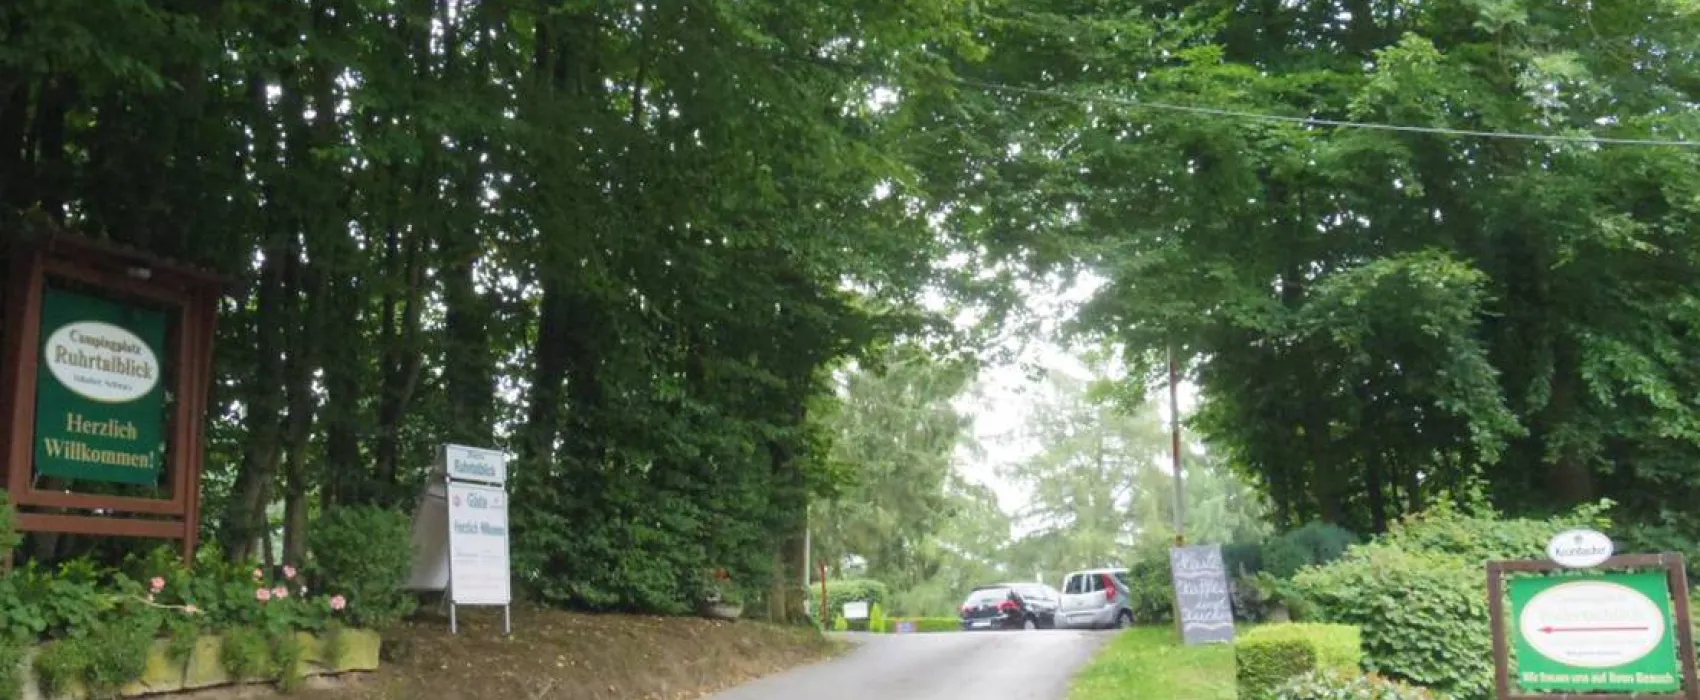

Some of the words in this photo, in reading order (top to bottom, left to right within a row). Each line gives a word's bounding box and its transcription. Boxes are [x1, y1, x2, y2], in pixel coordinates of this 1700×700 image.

[69, 328, 142, 355] Campingplatz
[54, 345, 153, 379] Ruhrtalblick
[66, 411, 138, 440] Herzlich
[44, 436, 154, 468] Willkommen!
